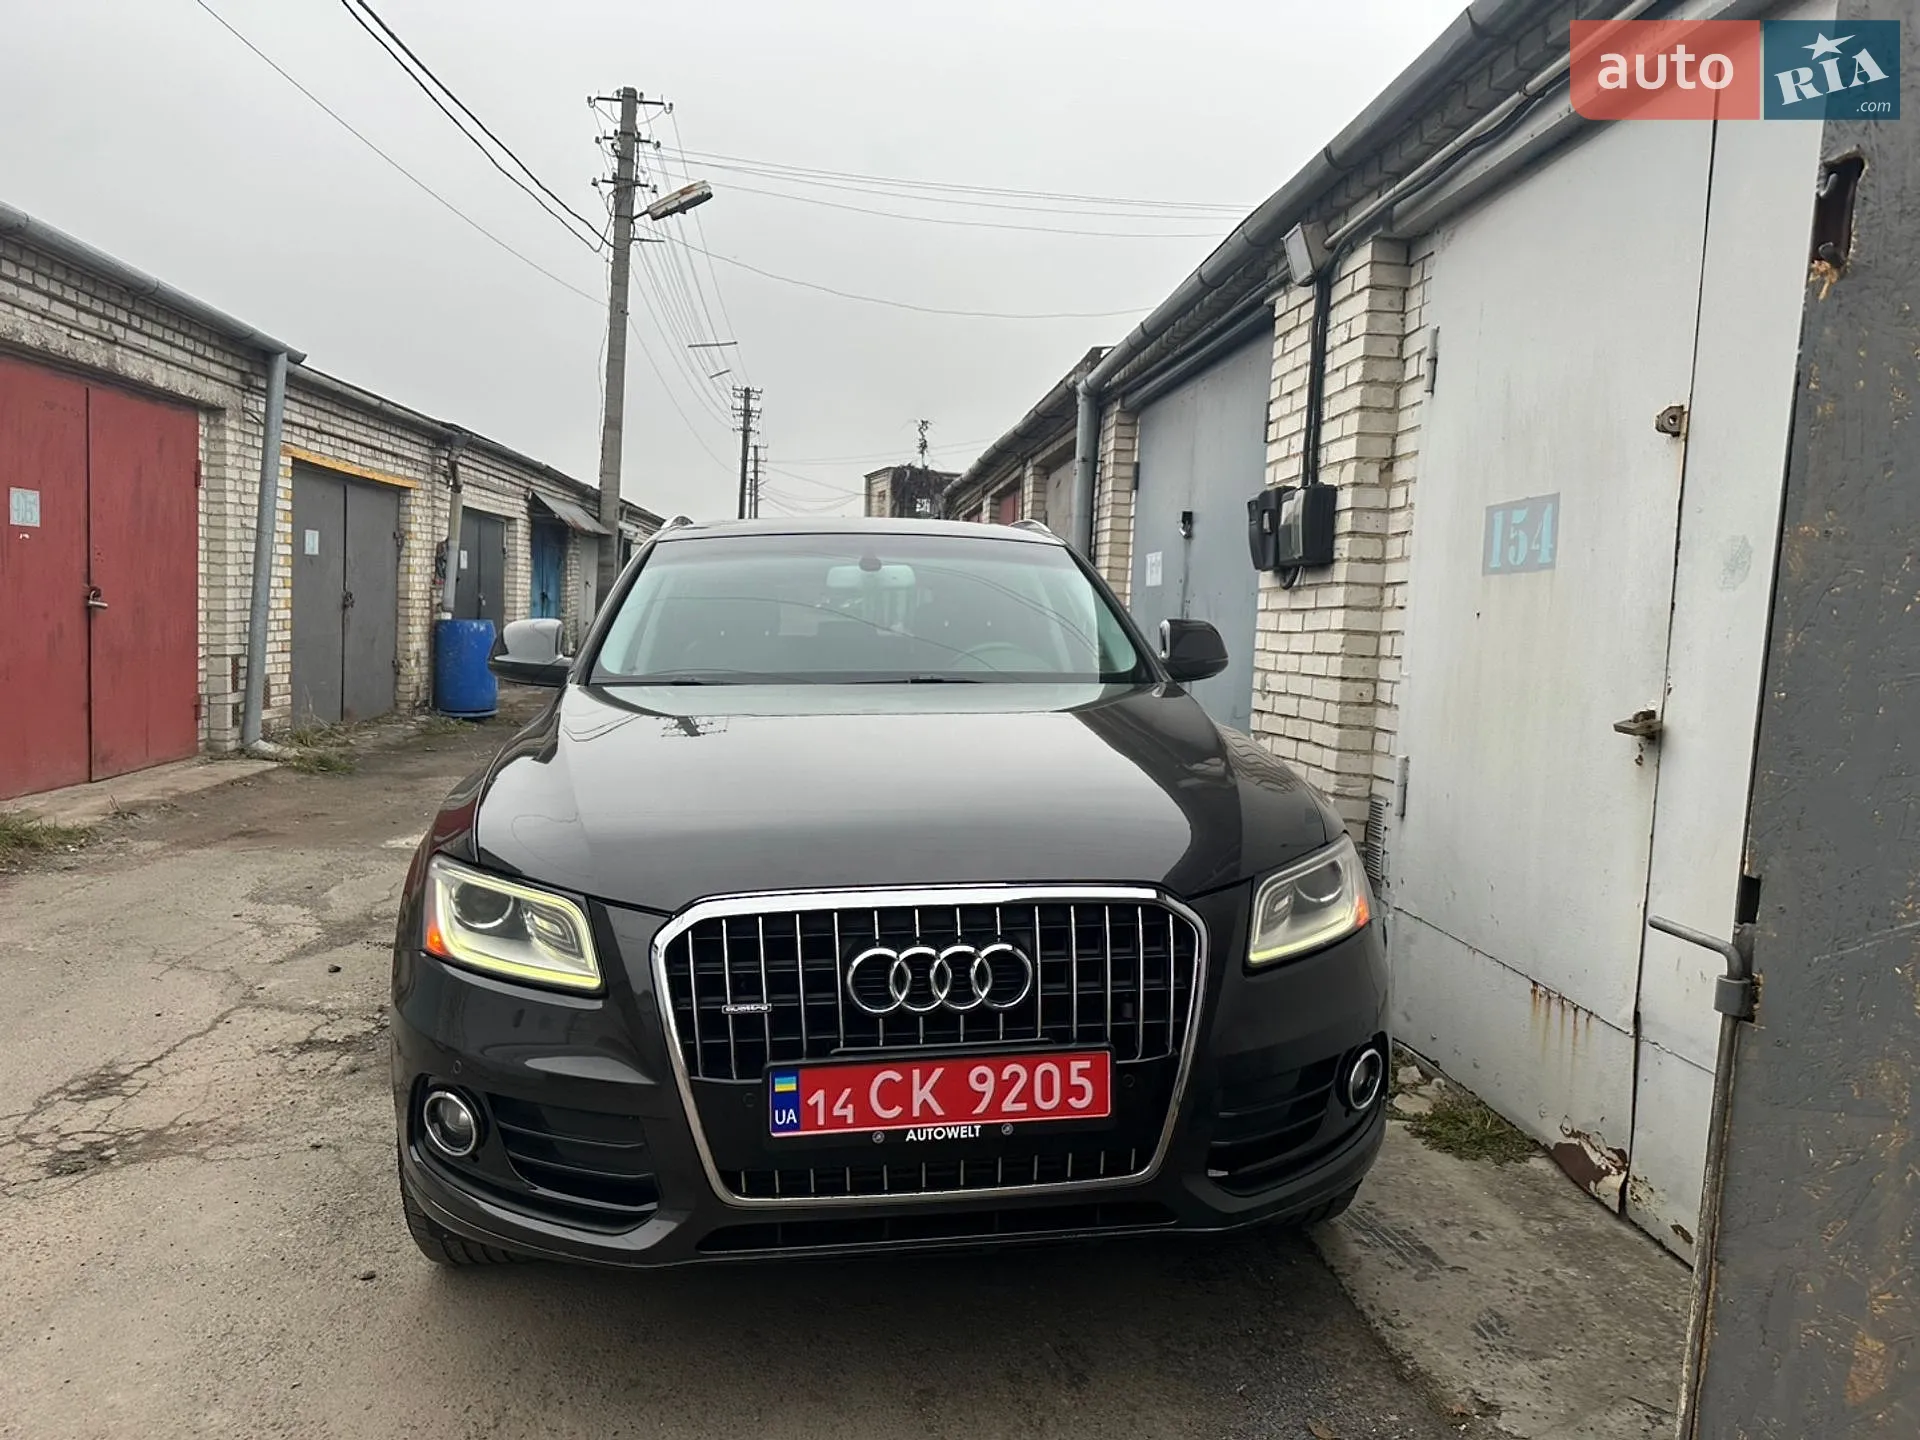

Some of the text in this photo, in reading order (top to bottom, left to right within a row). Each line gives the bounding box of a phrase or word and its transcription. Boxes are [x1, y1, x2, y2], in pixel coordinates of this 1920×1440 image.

[1489, 503, 1554, 568] 154
[807, 1060, 1094, 1125] 14 CK 9205
[774, 1109, 797, 1125] UA
[905, 1126, 982, 1142] AUTOWELT
